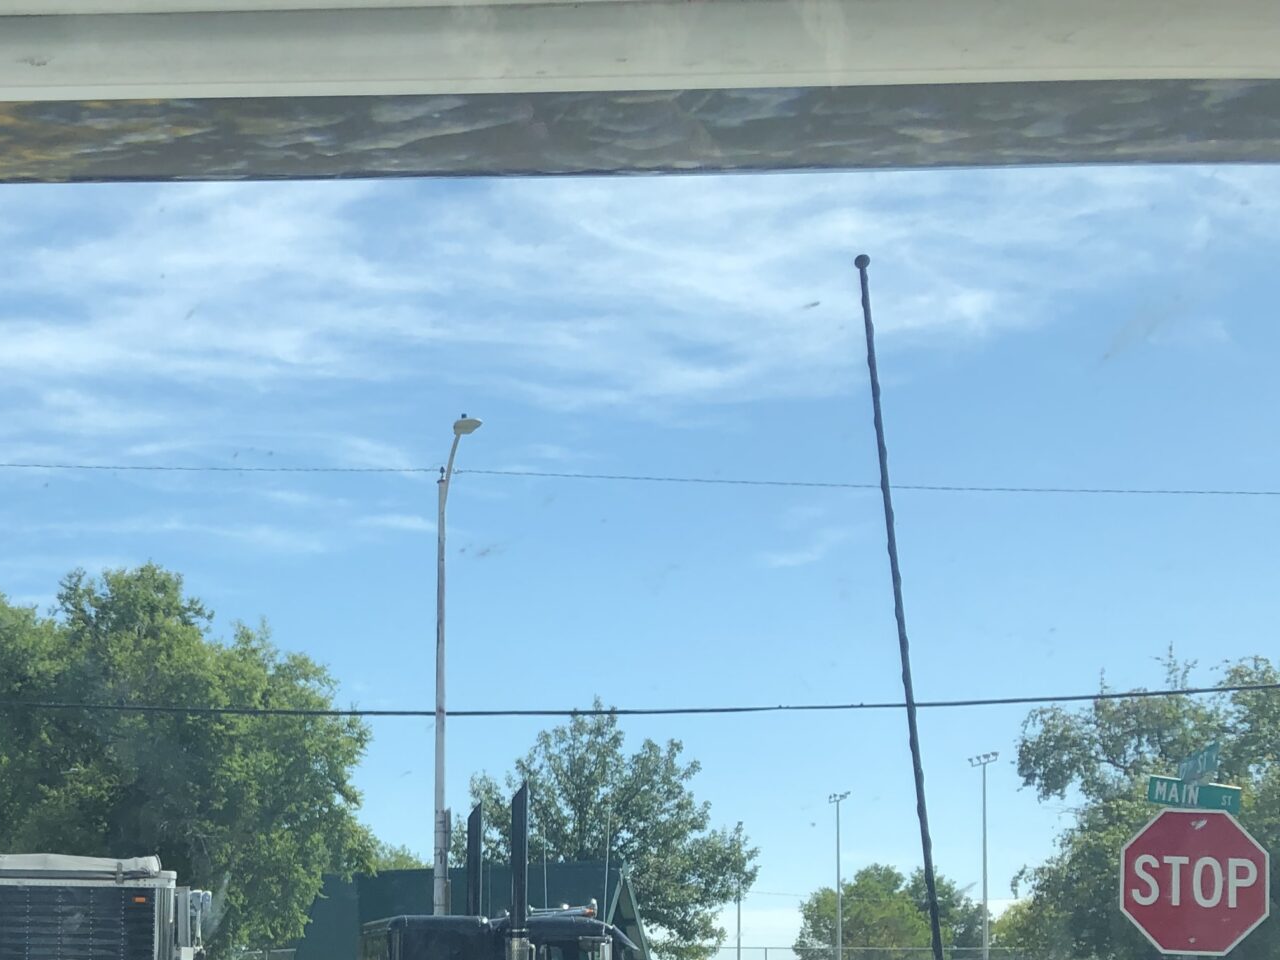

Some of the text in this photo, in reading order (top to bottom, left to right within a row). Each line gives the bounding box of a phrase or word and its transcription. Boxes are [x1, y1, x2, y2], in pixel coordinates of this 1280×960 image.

[1154, 780, 1233, 807] MAIN ST
[1131, 854, 1258, 909] STOP
